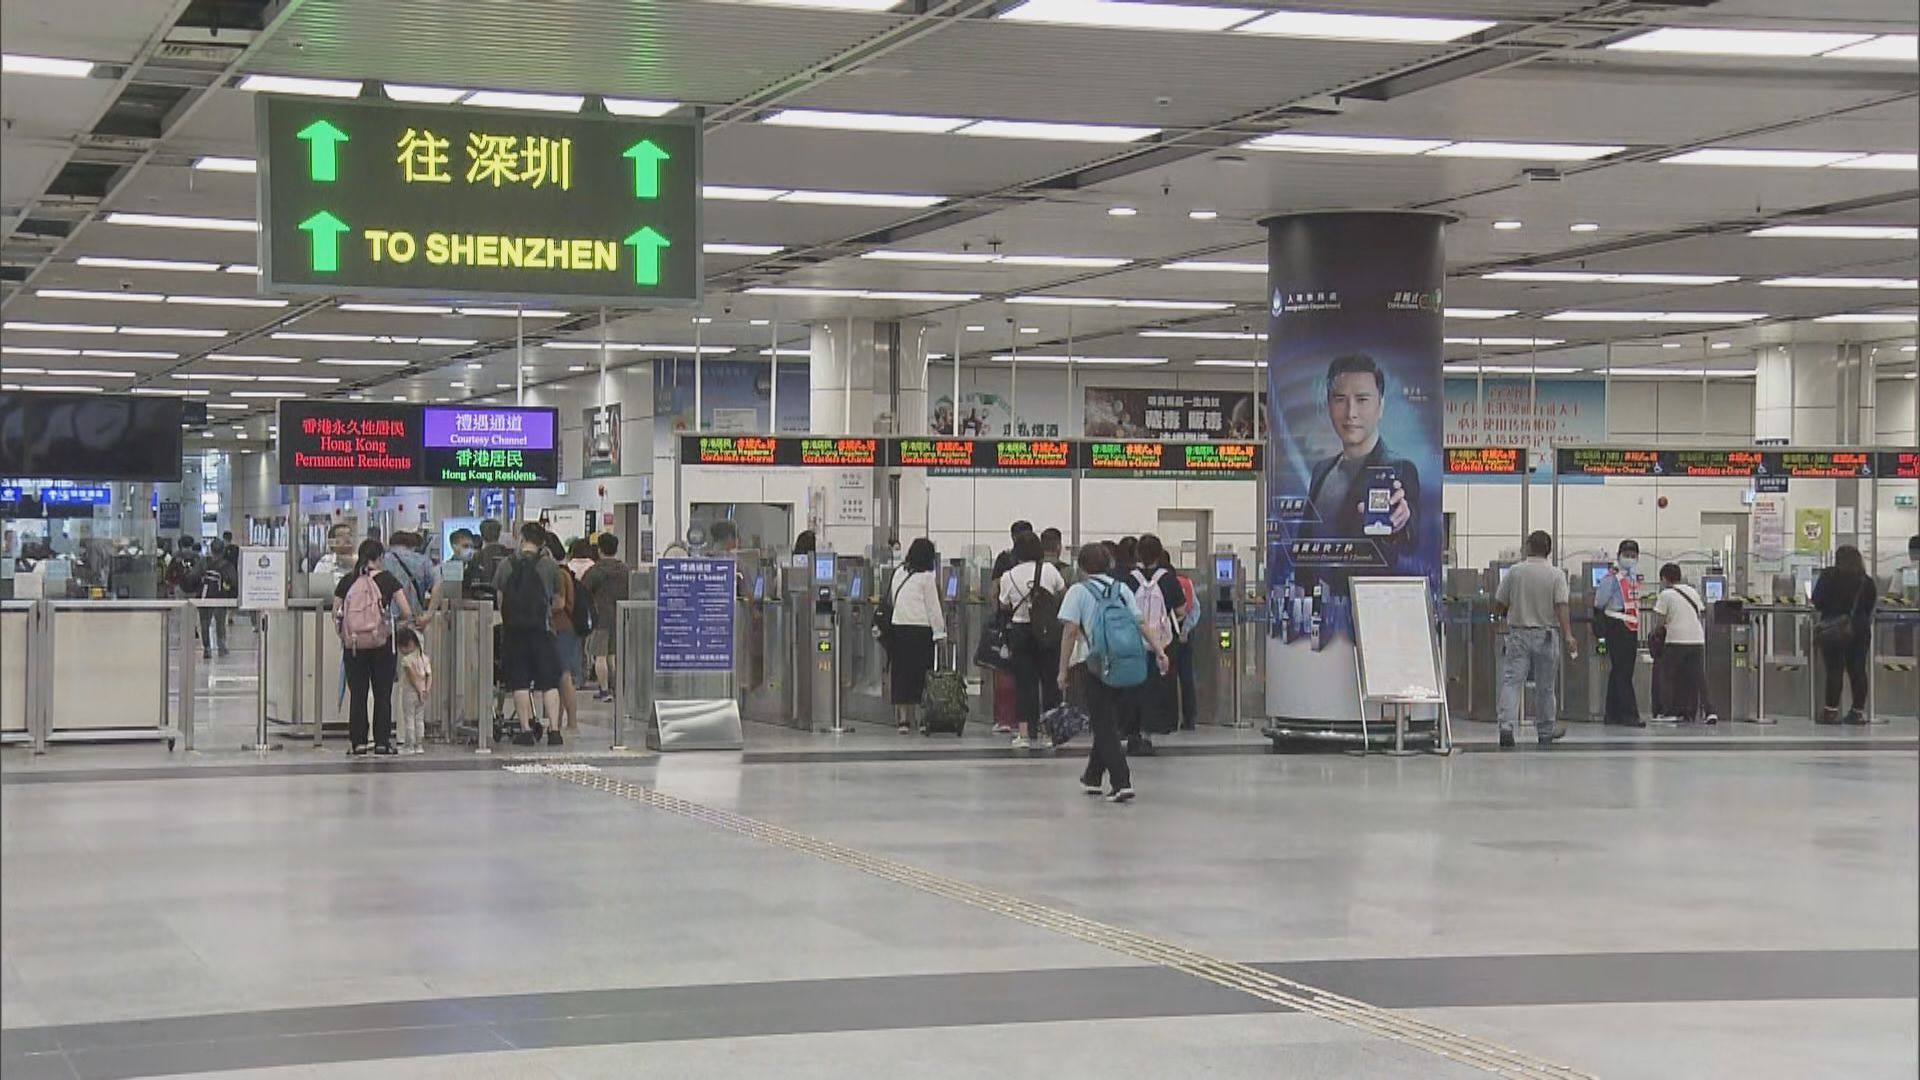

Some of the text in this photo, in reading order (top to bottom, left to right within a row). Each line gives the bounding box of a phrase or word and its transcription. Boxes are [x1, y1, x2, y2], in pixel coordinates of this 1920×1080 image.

[397, 128, 572, 191] 往 深圳
[365, 230, 617, 271] TO SHENZHEN
[303, 418, 405, 437] 香港永久性居民
[456, 413, 522, 431] 禮遇通道
[321, 436, 386, 453] Hong Kong
[450, 434, 527, 446] Courtesy Channel
[295, 452, 411, 469] Permanent Residents
[456, 449, 523, 467] 香港居民
[441, 469, 537, 481] Hong Kong Residents
[666, 573, 727, 583] Courtesy Channel
